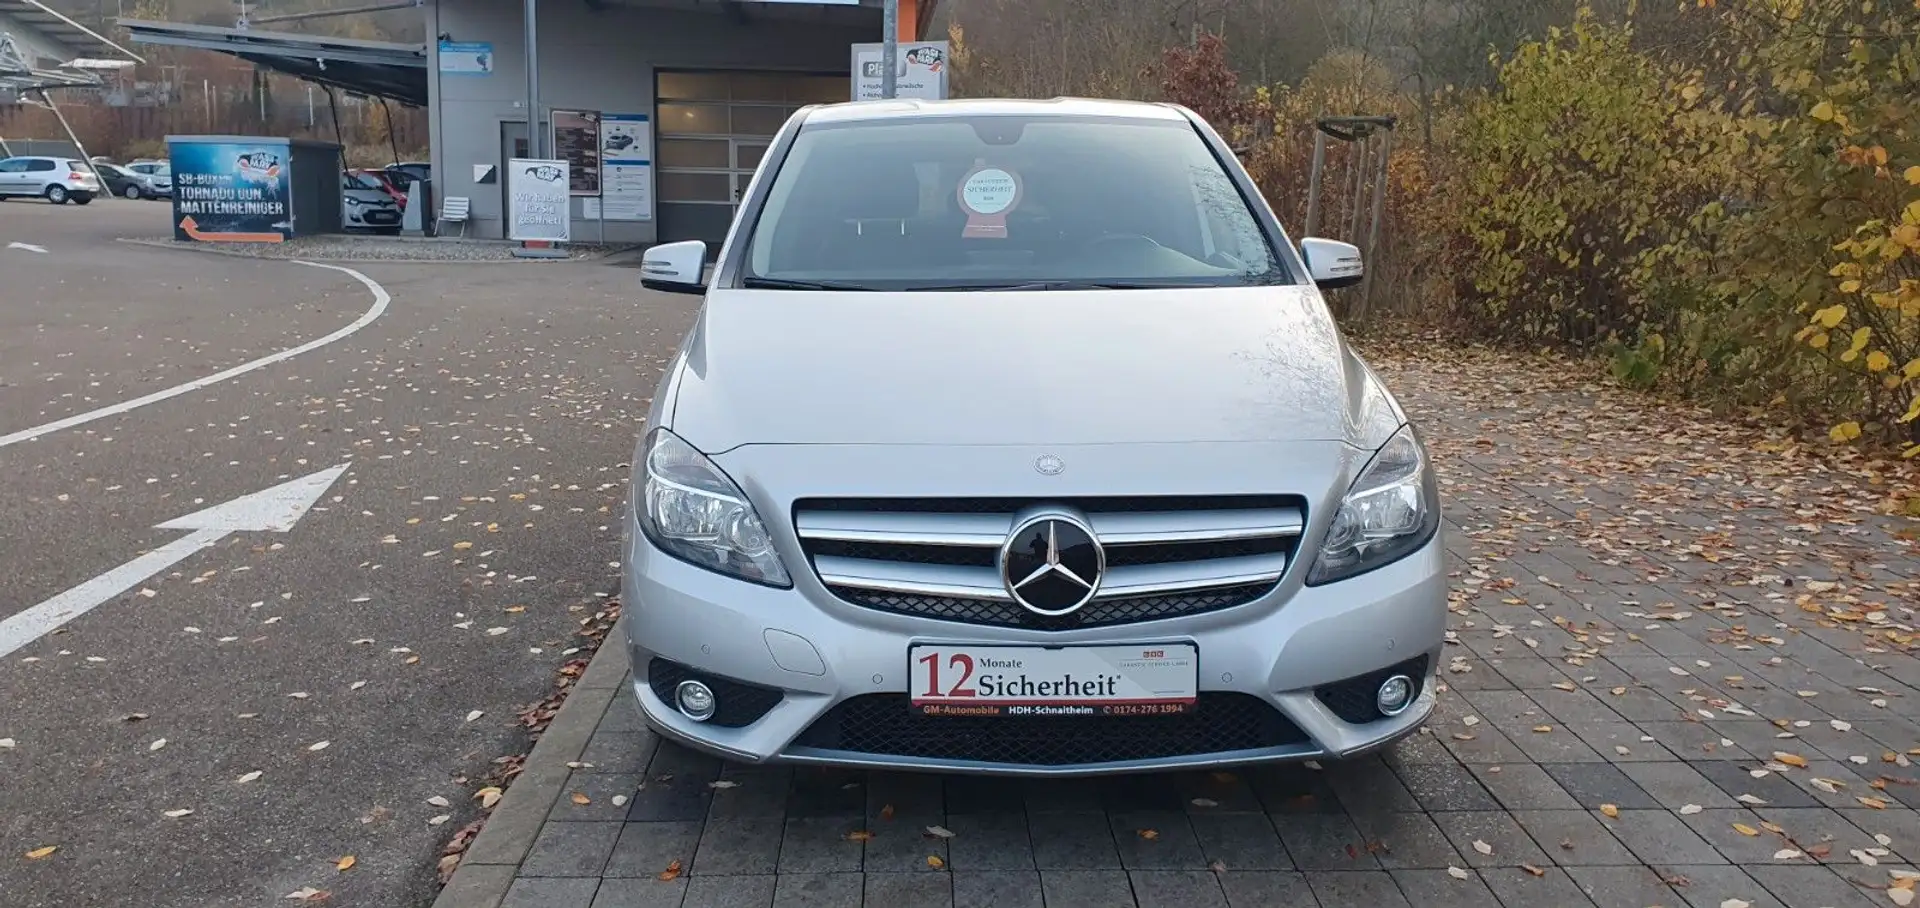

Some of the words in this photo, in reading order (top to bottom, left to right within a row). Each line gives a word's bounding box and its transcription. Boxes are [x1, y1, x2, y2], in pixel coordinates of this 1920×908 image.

[180, 187, 235, 200] TORNADO
[515, 193, 534, 203] Wir
[181, 201, 284, 215] MATTENREINIGER
[919, 652, 976, 698] 12
[980, 658, 1022, 668] Monate
[923, 705, 1000, 715] GM-Automobile
[1008, 705, 1094, 715] HDH-Schnaitheim
[1113, 705, 1158, 714] 0174-276
[1161, 703, 1183, 713] 1994
